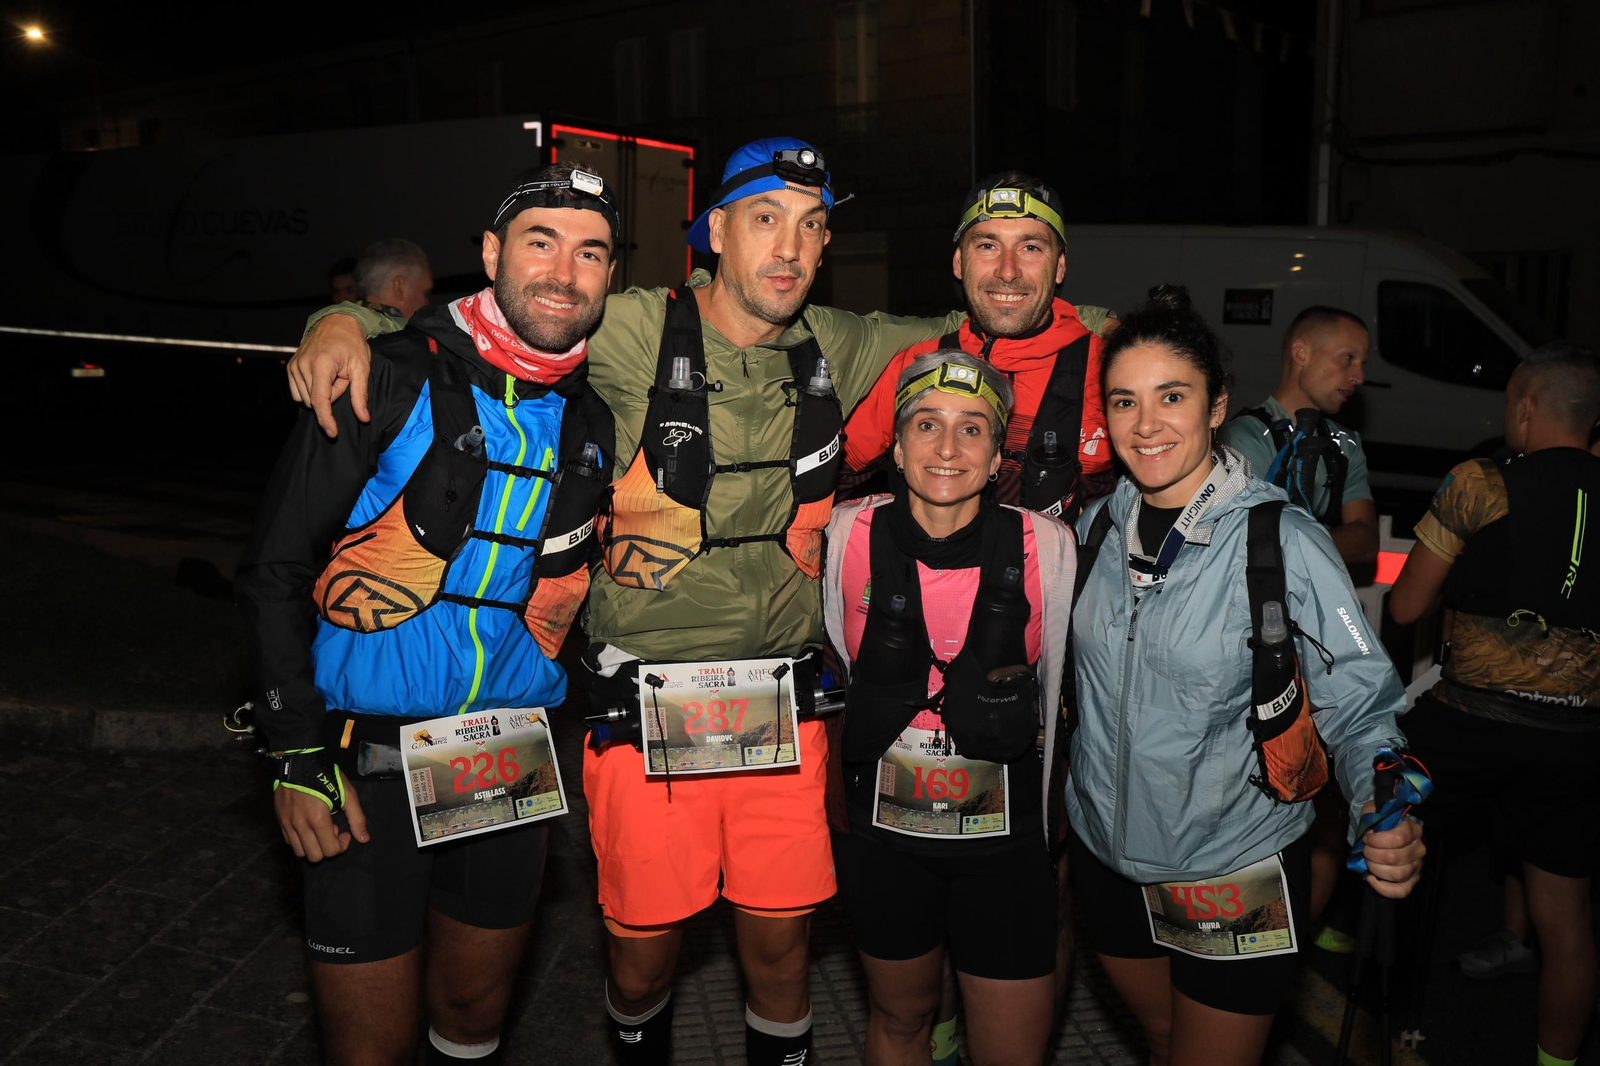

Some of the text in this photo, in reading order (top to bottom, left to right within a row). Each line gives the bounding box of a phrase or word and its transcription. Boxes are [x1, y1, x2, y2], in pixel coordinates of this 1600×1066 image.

[202, 208, 309, 236] CUEVAS
[491, 329, 510, 343] new
[819, 438, 838, 462] BIG
[1181, 483, 1216, 530] ONNIGHT
[568, 522, 593, 546] BIG
[1336, 606, 1371, 656] SALOMON
[691, 674, 725, 683] RIBEIRA
[698, 681, 726, 689] SACRA
[1272, 685, 1296, 714] BIG
[461, 716, 489, 727] TRAIL
[683, 698, 751, 735] 287
[455, 724, 490, 736] RIBEIRA
[463, 732, 491, 742] SACRA
[450, 748, 520, 794] 226
[912, 766, 970, 800] 169
[316, 772, 340, 801] LEKI
[474, 786, 506, 801] ASTILLASS
[932, 802, 949, 810] KARI
[1168, 883, 1244, 920] 453
[1198, 921, 1221, 930] LAURA
[307, 938, 356, 954] LURBEL
